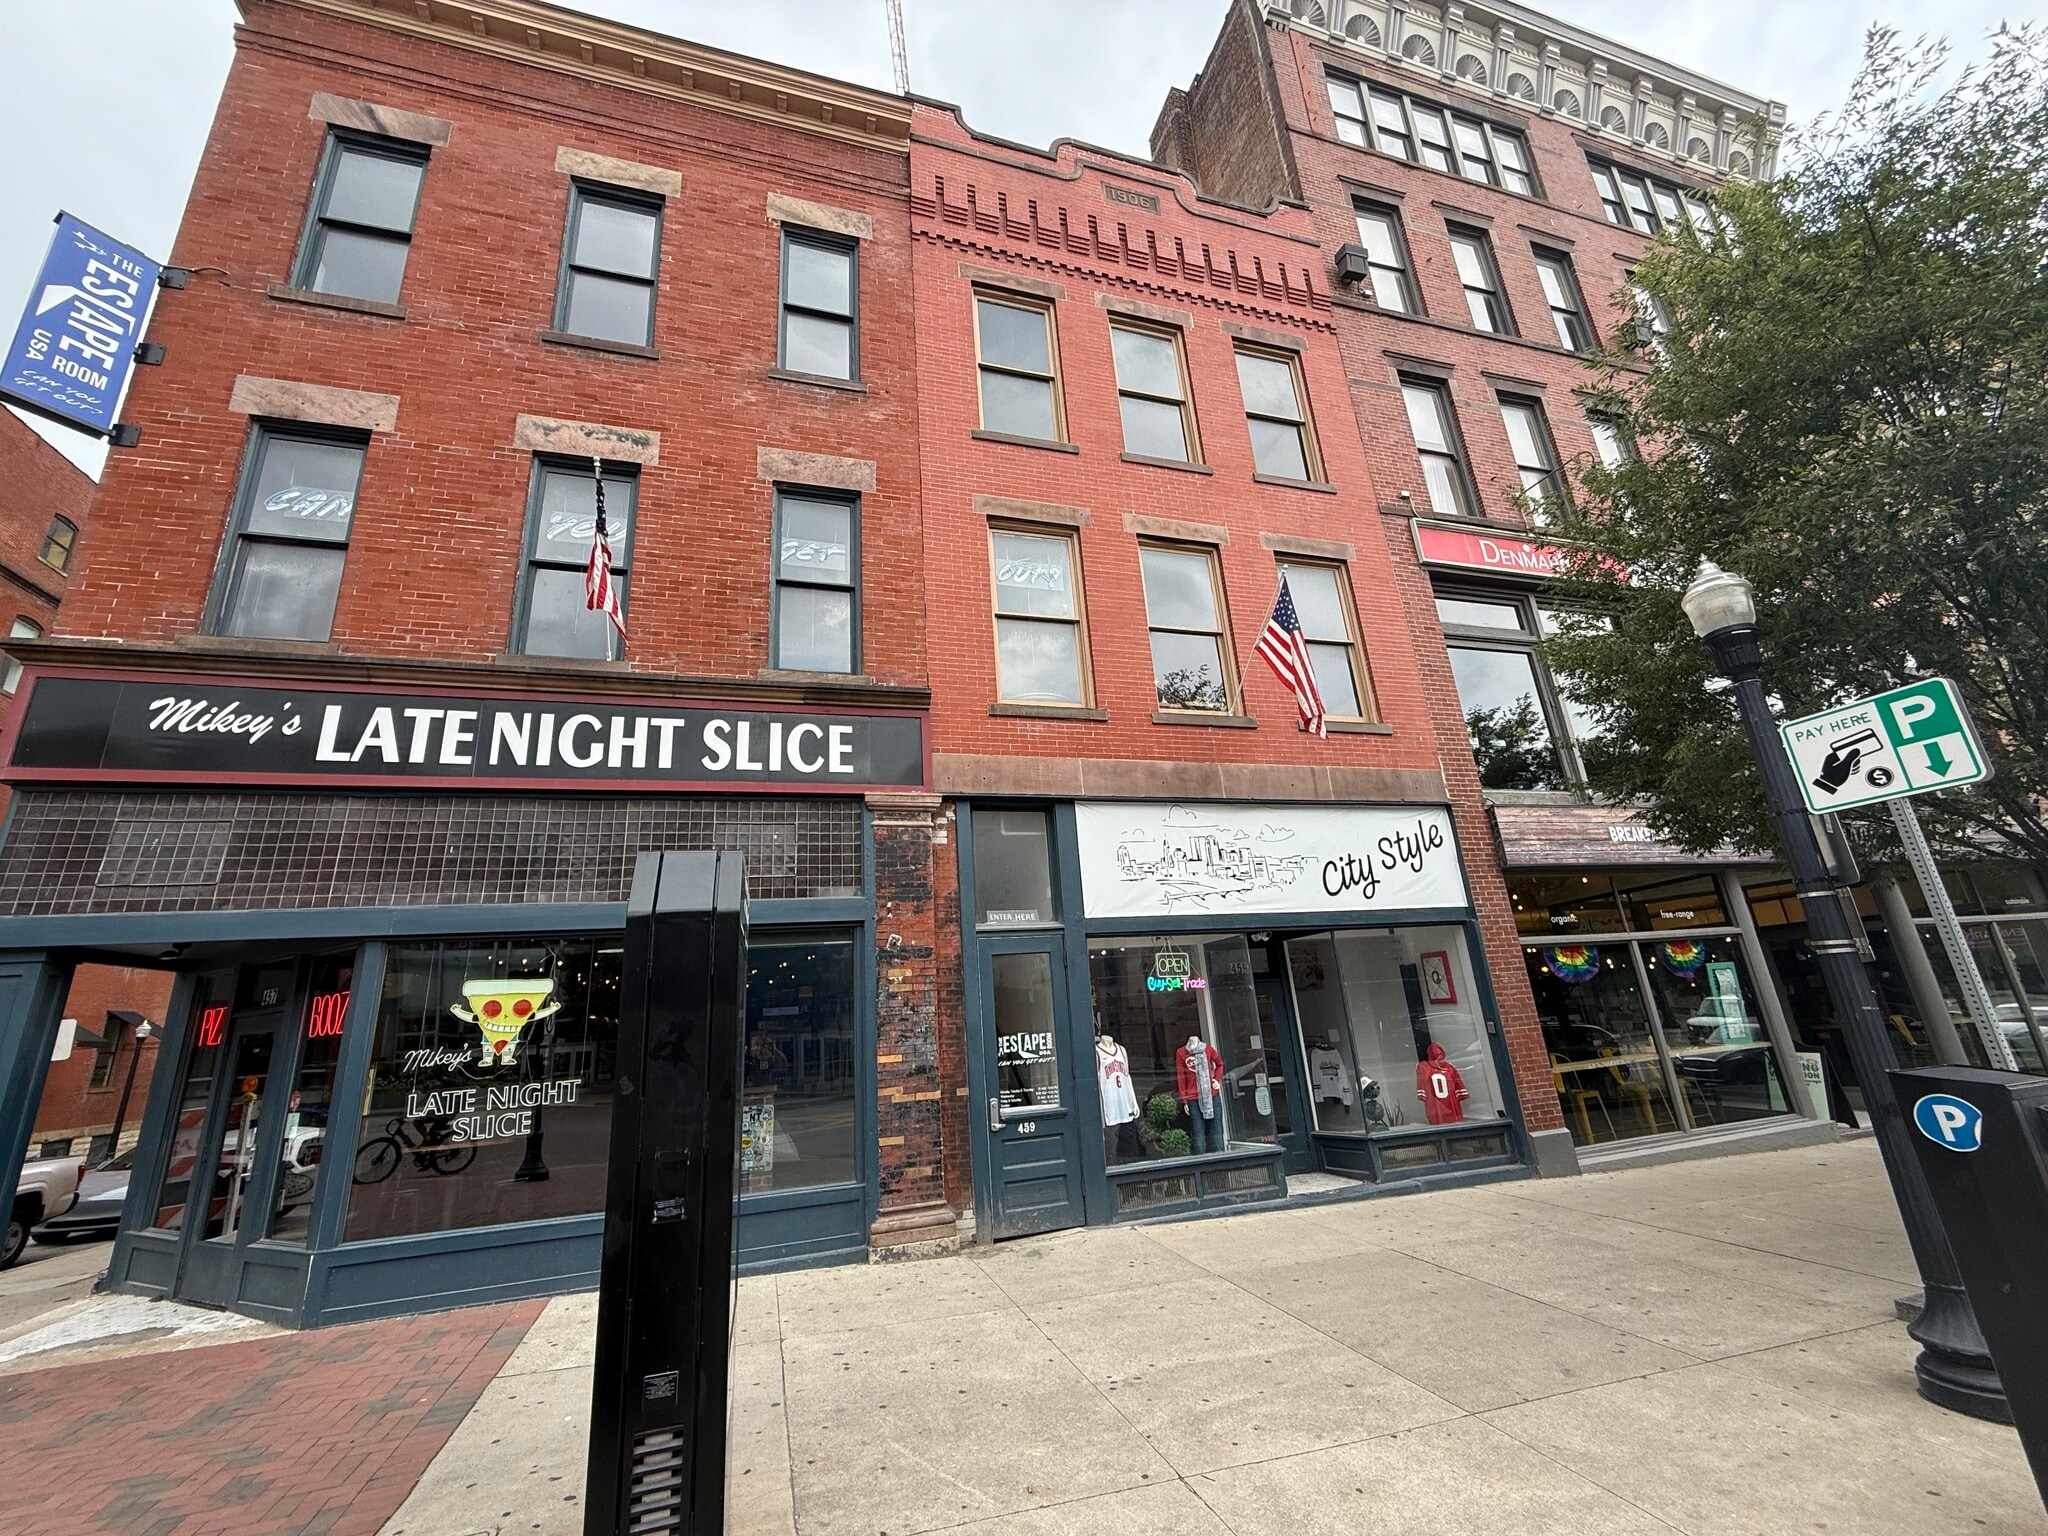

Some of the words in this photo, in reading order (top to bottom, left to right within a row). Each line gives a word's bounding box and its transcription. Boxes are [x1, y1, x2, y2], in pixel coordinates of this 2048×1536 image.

[1110, 188, 1150, 208] 1906
[112, 253, 144, 279] THE
[25, 328, 52, 361] USA
[22, 370, 63, 387] CAN
[66, 386, 102, 404] YOU
[51, 354, 109, 391] ROOM
[14, 377, 52, 392] GET
[53, 393, 104, 414] OUT?
[1795, 725, 1824, 743] PAY
[1829, 711, 1872, 733] HERE
[1889, 695, 1936, 740] P
[149, 697, 302, 744] Mikey's
[315, 704, 478, 765] LATE
[488, 711, 685, 769] NIGHT
[701, 718, 854, 773] SLICE
[1322, 852, 1381, 900] City
[1378, 819, 1443, 873] Style
[989, 913, 1012, 921] ENTER
[1014, 913, 1036, 921] HERE
[1550, 914, 1579, 925] organic
[1159, 958, 1188, 972] OPEN
[402, 1043, 472, 1072] Mikey's
[406, 1089, 476, 1118] LATE
[486, 1079, 582, 1111] NIGHT
[451, 1111, 532, 1142] SLICE
[1018, 1122, 1036, 1133] 459
[1932, 1104, 1967, 1142] P
